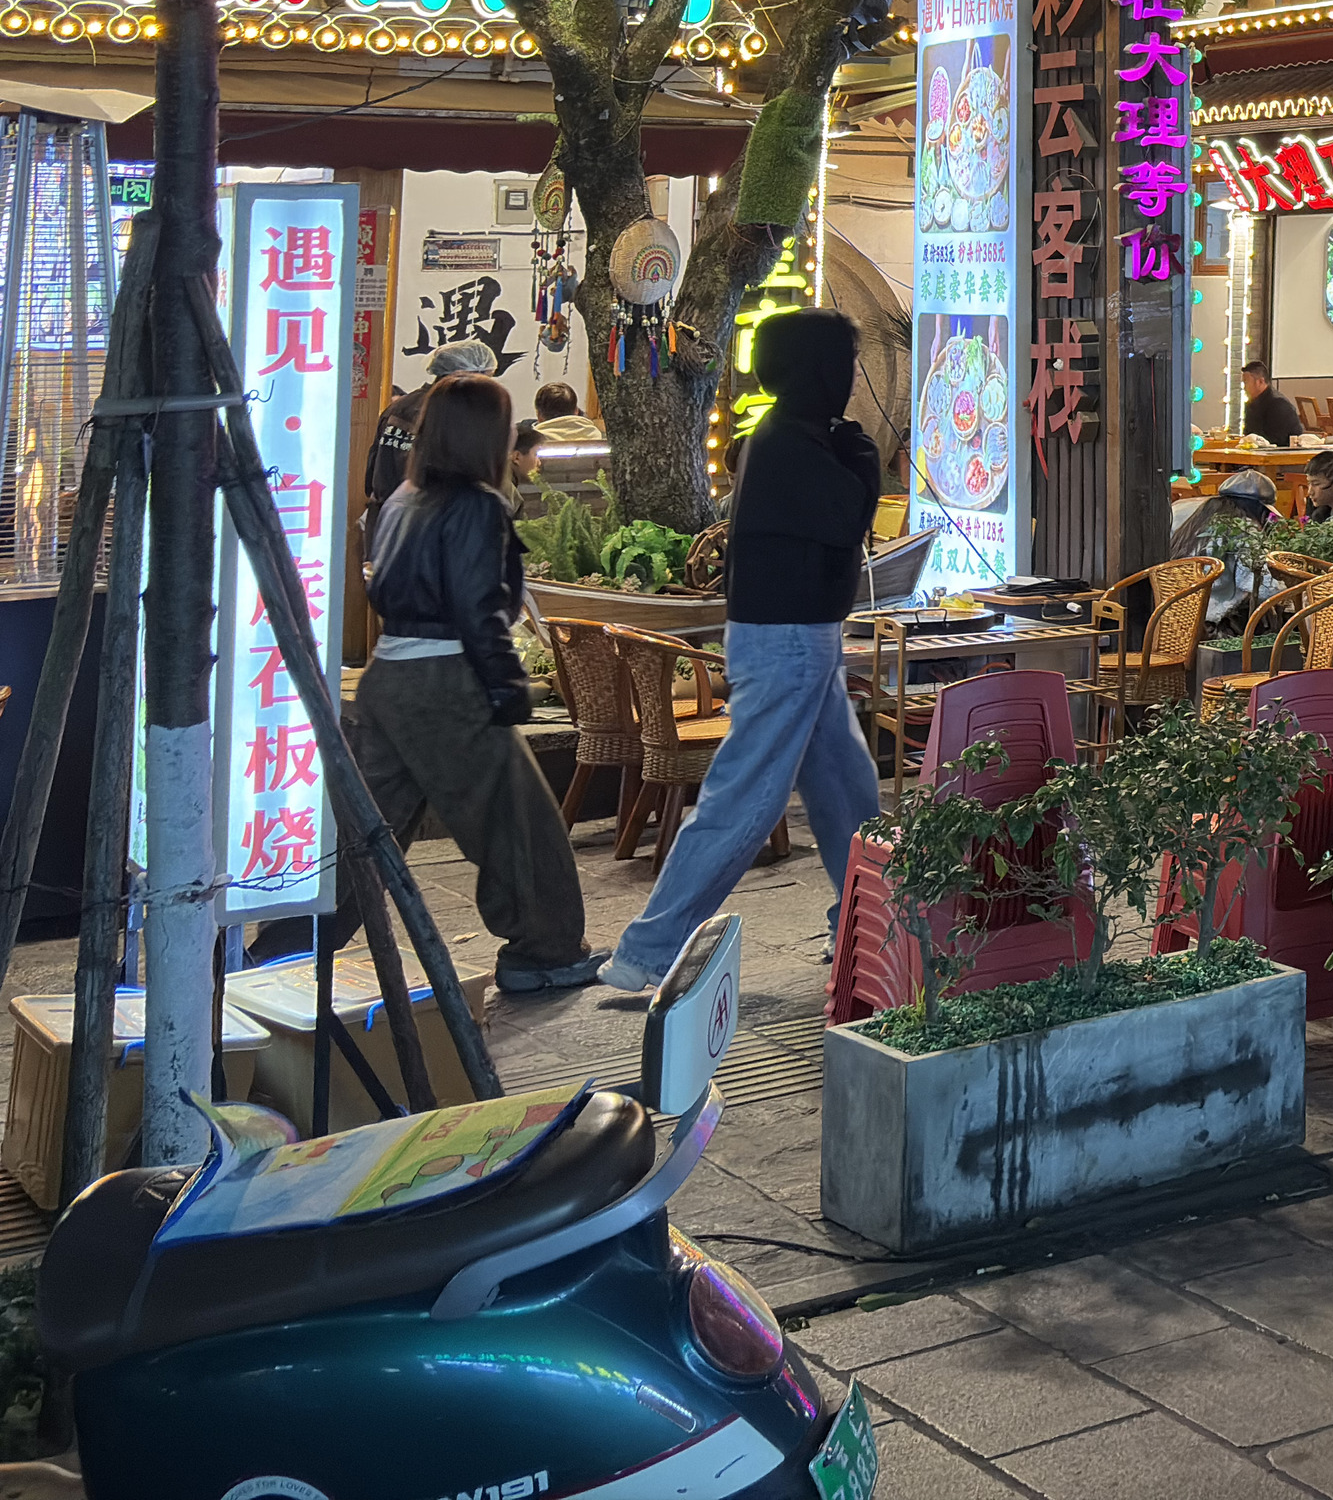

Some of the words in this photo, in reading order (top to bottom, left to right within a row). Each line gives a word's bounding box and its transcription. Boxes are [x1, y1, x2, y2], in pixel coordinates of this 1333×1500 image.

[920, 268, 1008, 304] 家庭豪华套餐
